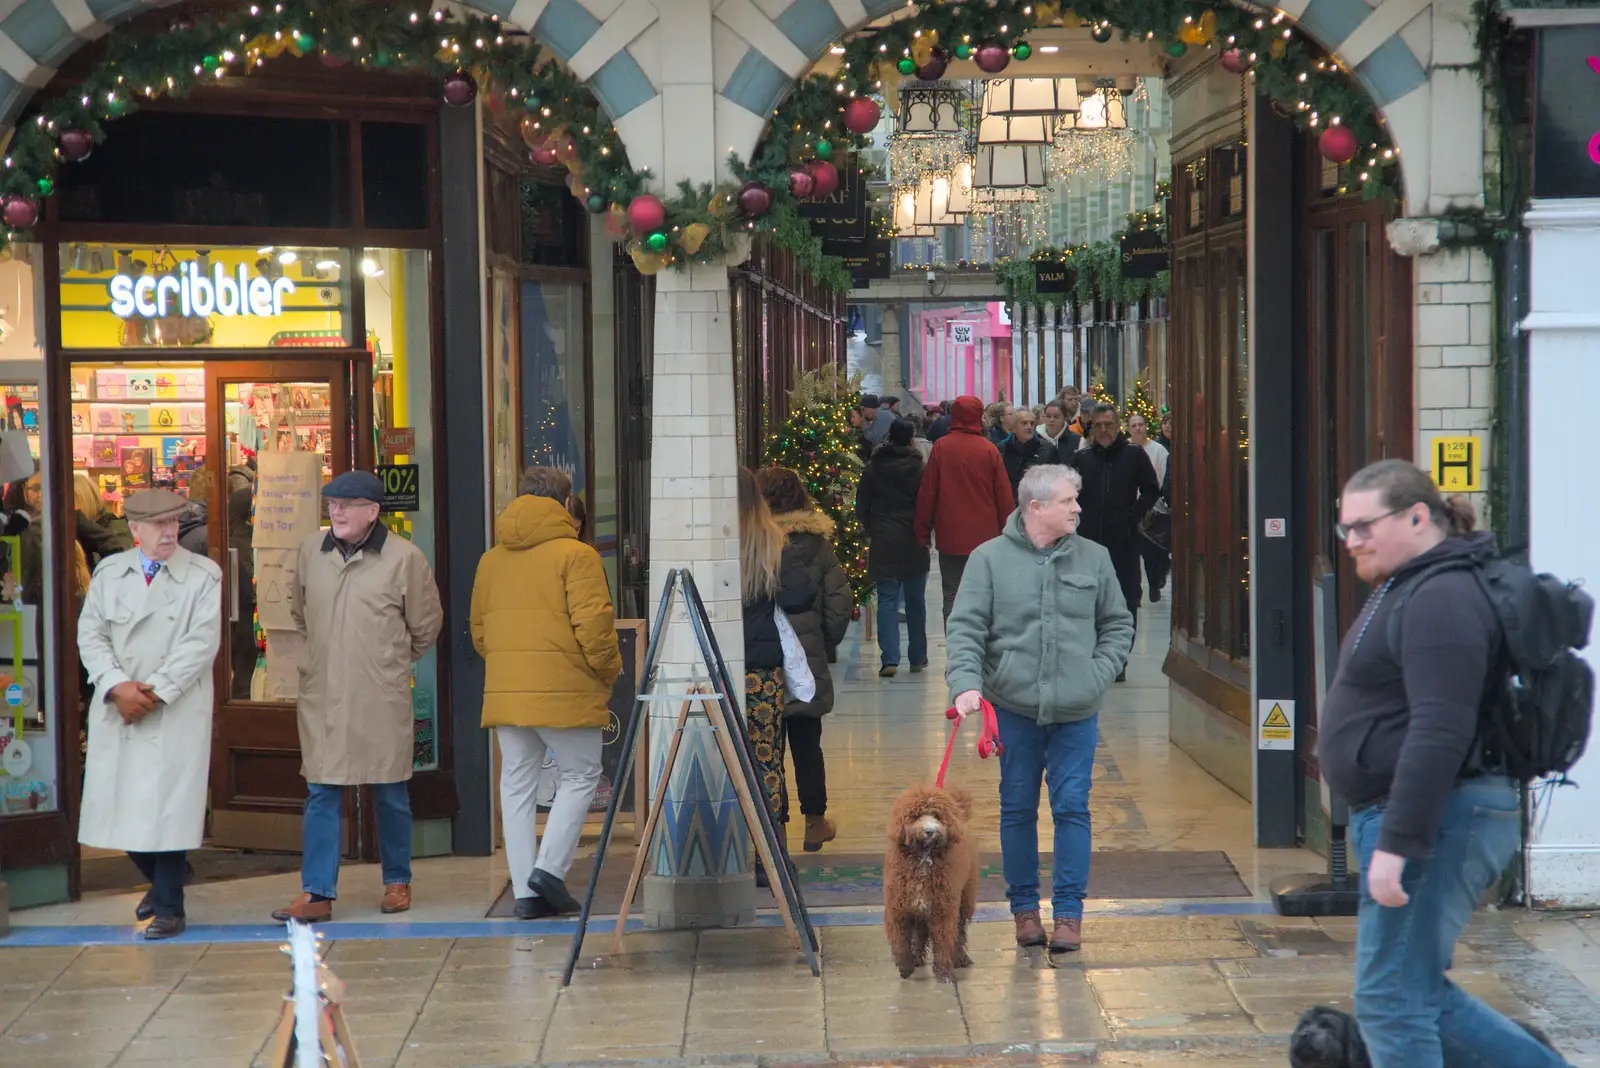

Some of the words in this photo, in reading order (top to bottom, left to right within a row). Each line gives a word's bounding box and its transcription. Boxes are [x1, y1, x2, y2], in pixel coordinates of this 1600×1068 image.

[1040, 272, 1065, 281] YALM
[110, 261, 296, 318] scribbler
[385, 435, 409, 444] ALERT
[380, 468, 415, 493] 10%
